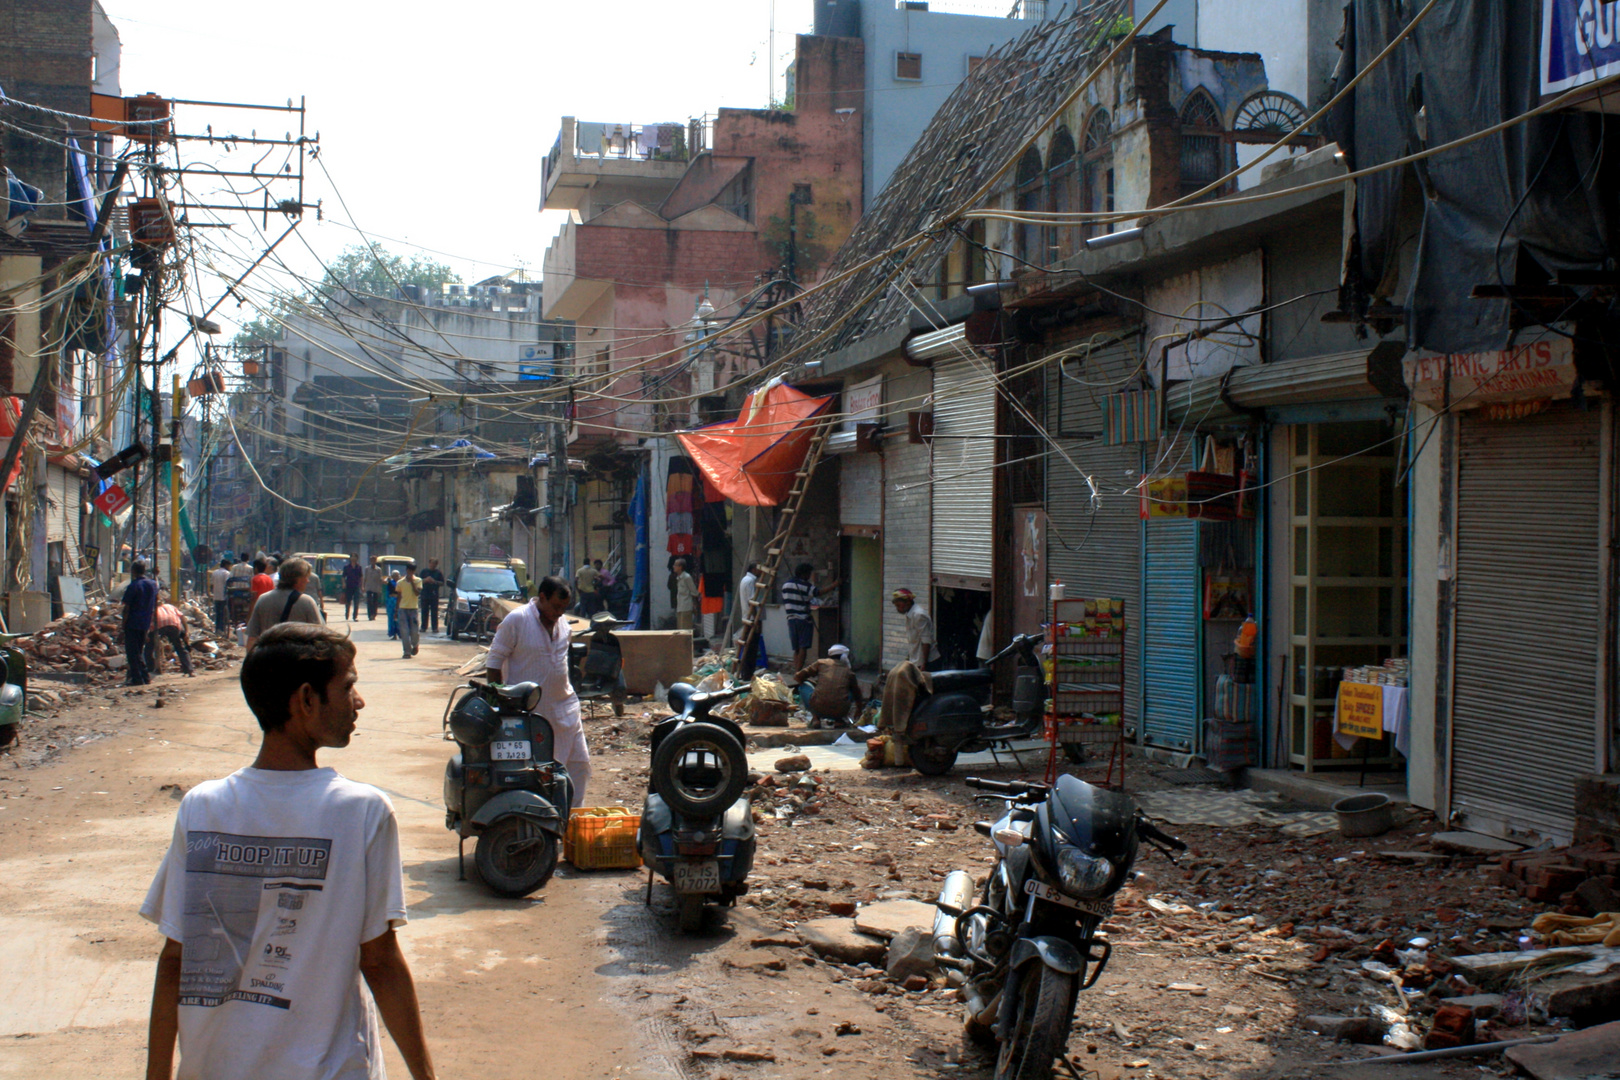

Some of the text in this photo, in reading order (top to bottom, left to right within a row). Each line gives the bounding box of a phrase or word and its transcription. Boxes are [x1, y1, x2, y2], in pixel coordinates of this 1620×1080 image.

[1420, 352, 1490, 381] ETHNIC
[1497, 341, 1551, 374] ARTS
[496, 741, 523, 750] DL 6S
[187, 834, 220, 853] 2006
[216, 842, 328, 867] HOOP IT UP
[689, 878, 717, 890] 7072
[1027, 881, 1041, 896] DL
[250, 978, 285, 992] SPALDING
[180, 996, 201, 1005] ARE
[202, 997, 220, 1006] YOU
[259, 995, 272, 1004] IT?
